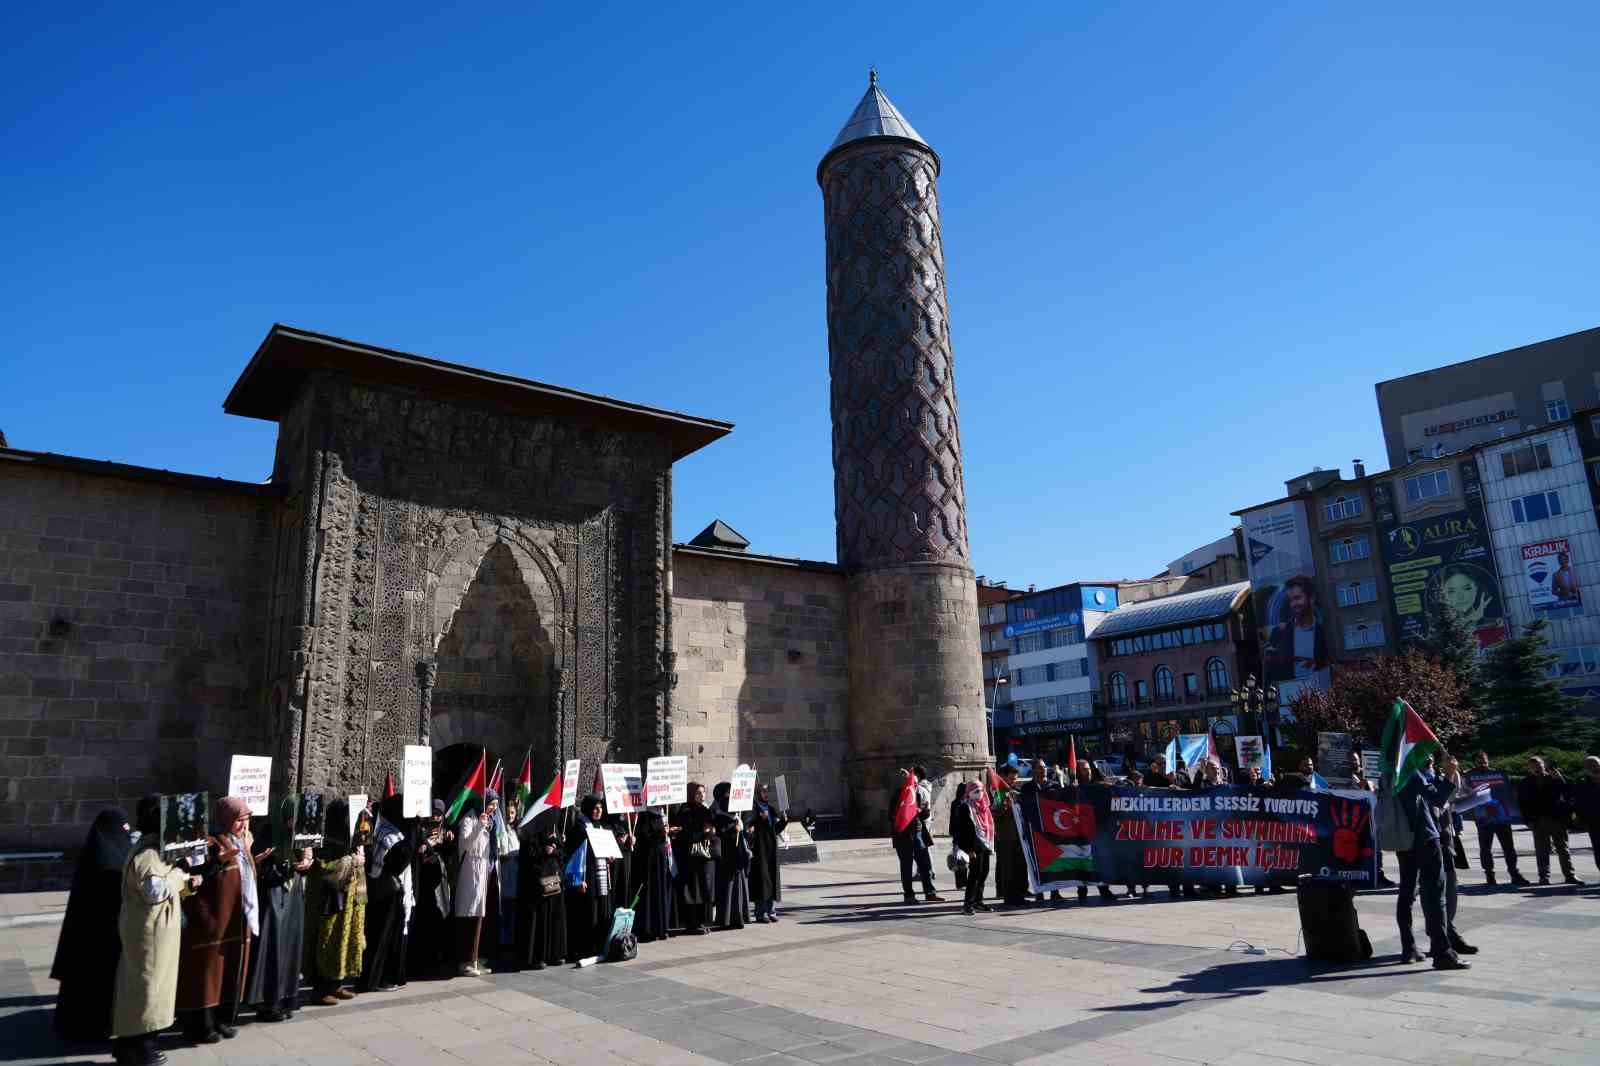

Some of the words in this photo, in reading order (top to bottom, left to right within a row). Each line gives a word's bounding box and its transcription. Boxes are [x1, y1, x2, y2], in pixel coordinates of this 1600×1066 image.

[1423, 517, 1477, 538] AURA
[1110, 793, 1211, 811] HEKİMLERDEN
[1214, 793, 1260, 811] SESSİZ
[1189, 818, 1217, 841] VE
[1143, 847, 1184, 868] DUR
[1190, 846, 1249, 868] DEMEK
